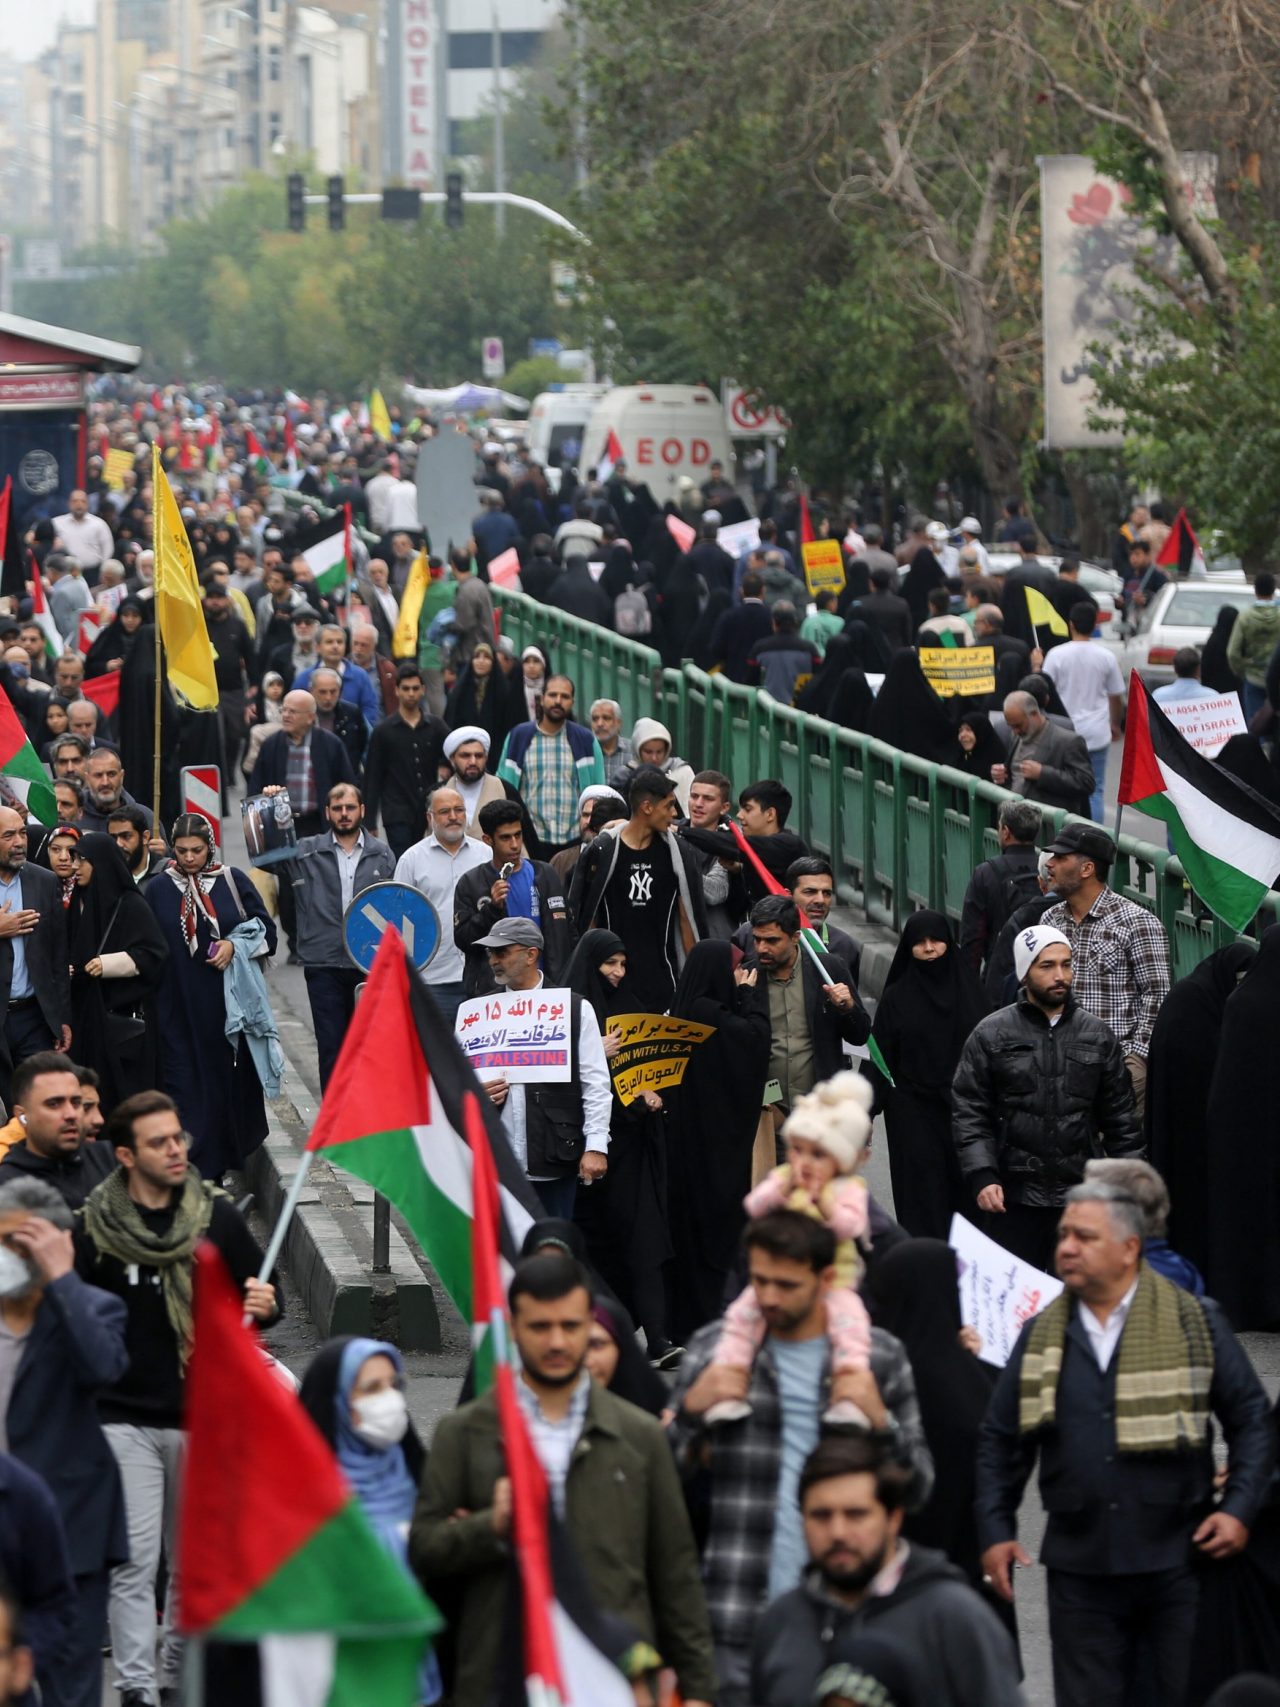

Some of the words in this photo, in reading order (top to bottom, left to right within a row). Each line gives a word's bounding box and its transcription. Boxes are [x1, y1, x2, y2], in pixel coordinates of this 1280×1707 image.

[637, 438, 711, 465] EOD
[1176, 704, 1198, 715] AQSA
[1200, 699, 1232, 711] STORM
[1187, 724, 1198, 734] OF
[1201, 718, 1237, 732] ISRAEL
[507, 996, 533, 1016] الله
[460, 1011, 480, 1031] مهر
[644, 1023, 662, 1038] بر
[506, 1024, 567, 1047] طوفان
[484, 1050, 567, 1066] PALESTINE
[610, 1050, 631, 1070] DOWN
[633, 1045, 658, 1059] WITH
[660, 1043, 693, 1053] U.S.A
[644, 1061, 683, 1085] الموت
